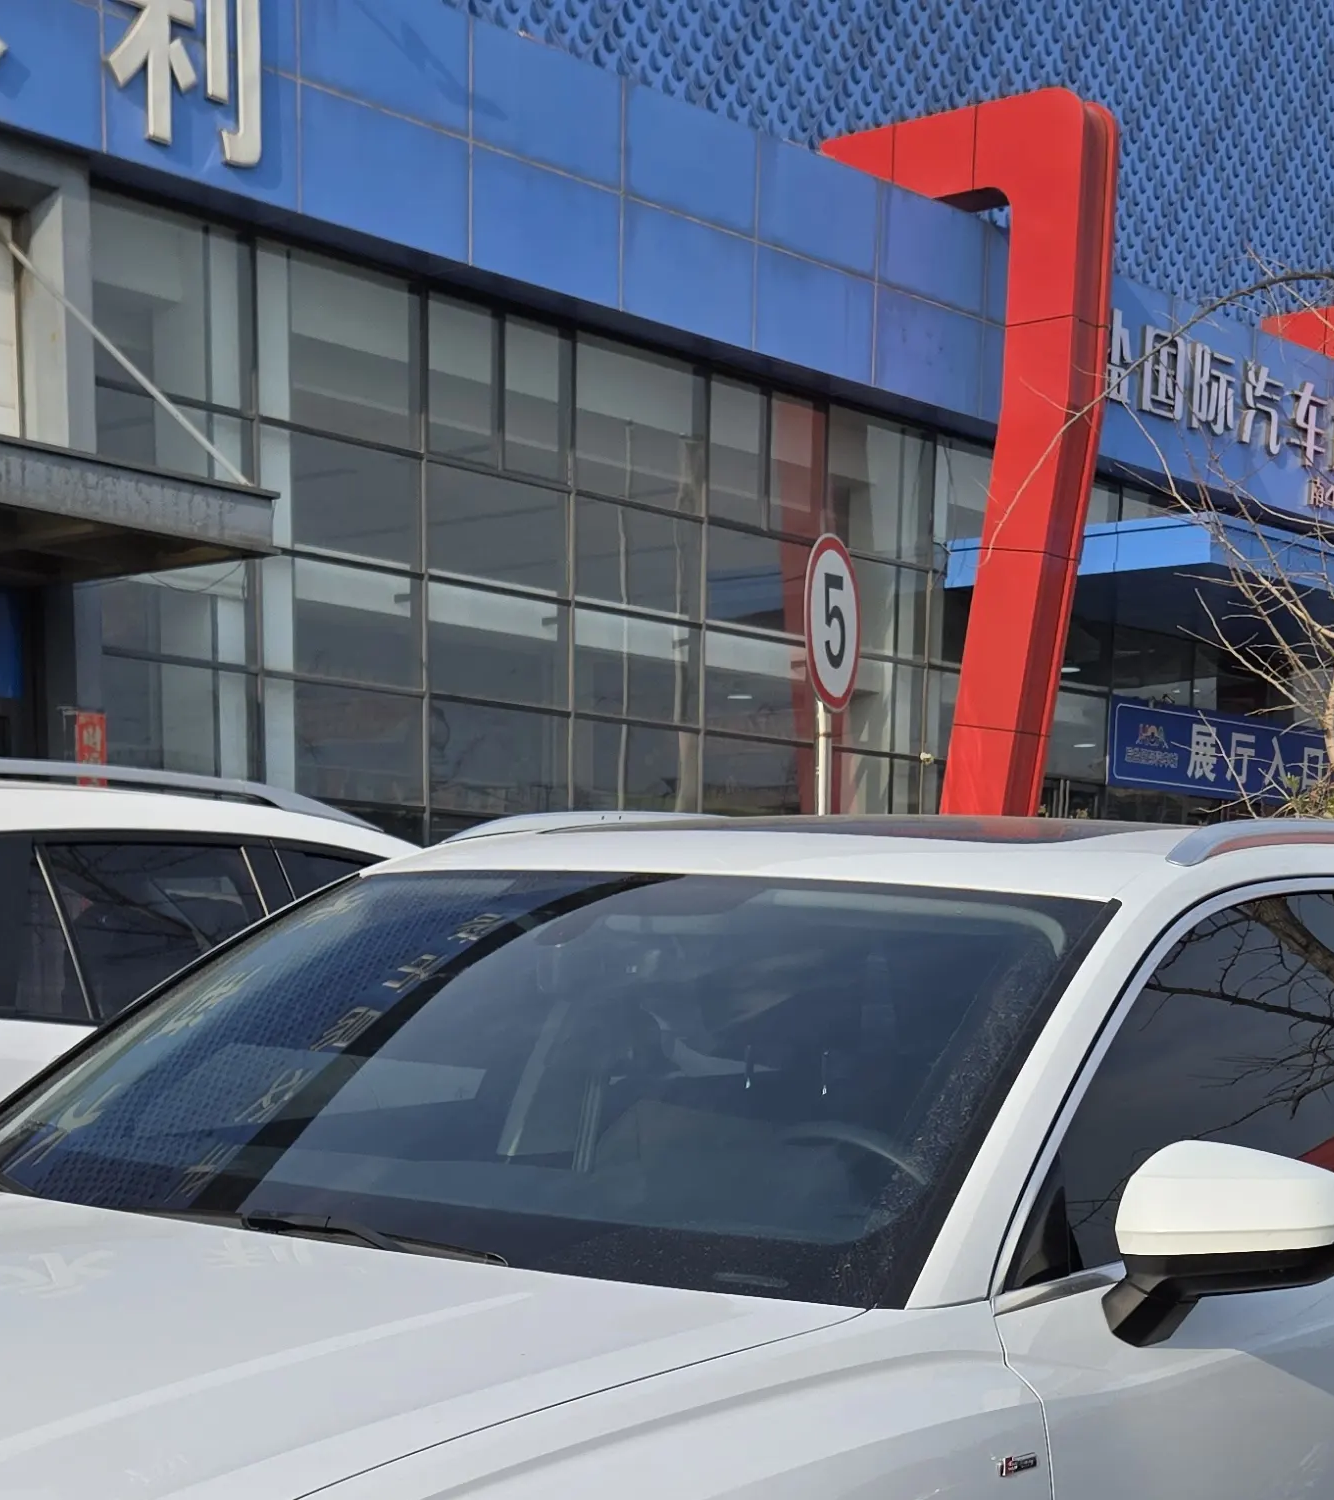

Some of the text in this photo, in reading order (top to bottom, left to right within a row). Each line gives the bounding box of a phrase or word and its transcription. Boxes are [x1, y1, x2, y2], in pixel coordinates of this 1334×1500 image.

[824, 572, 846, 670] 5
[1186, 723, 1324, 790] 展厅入口
